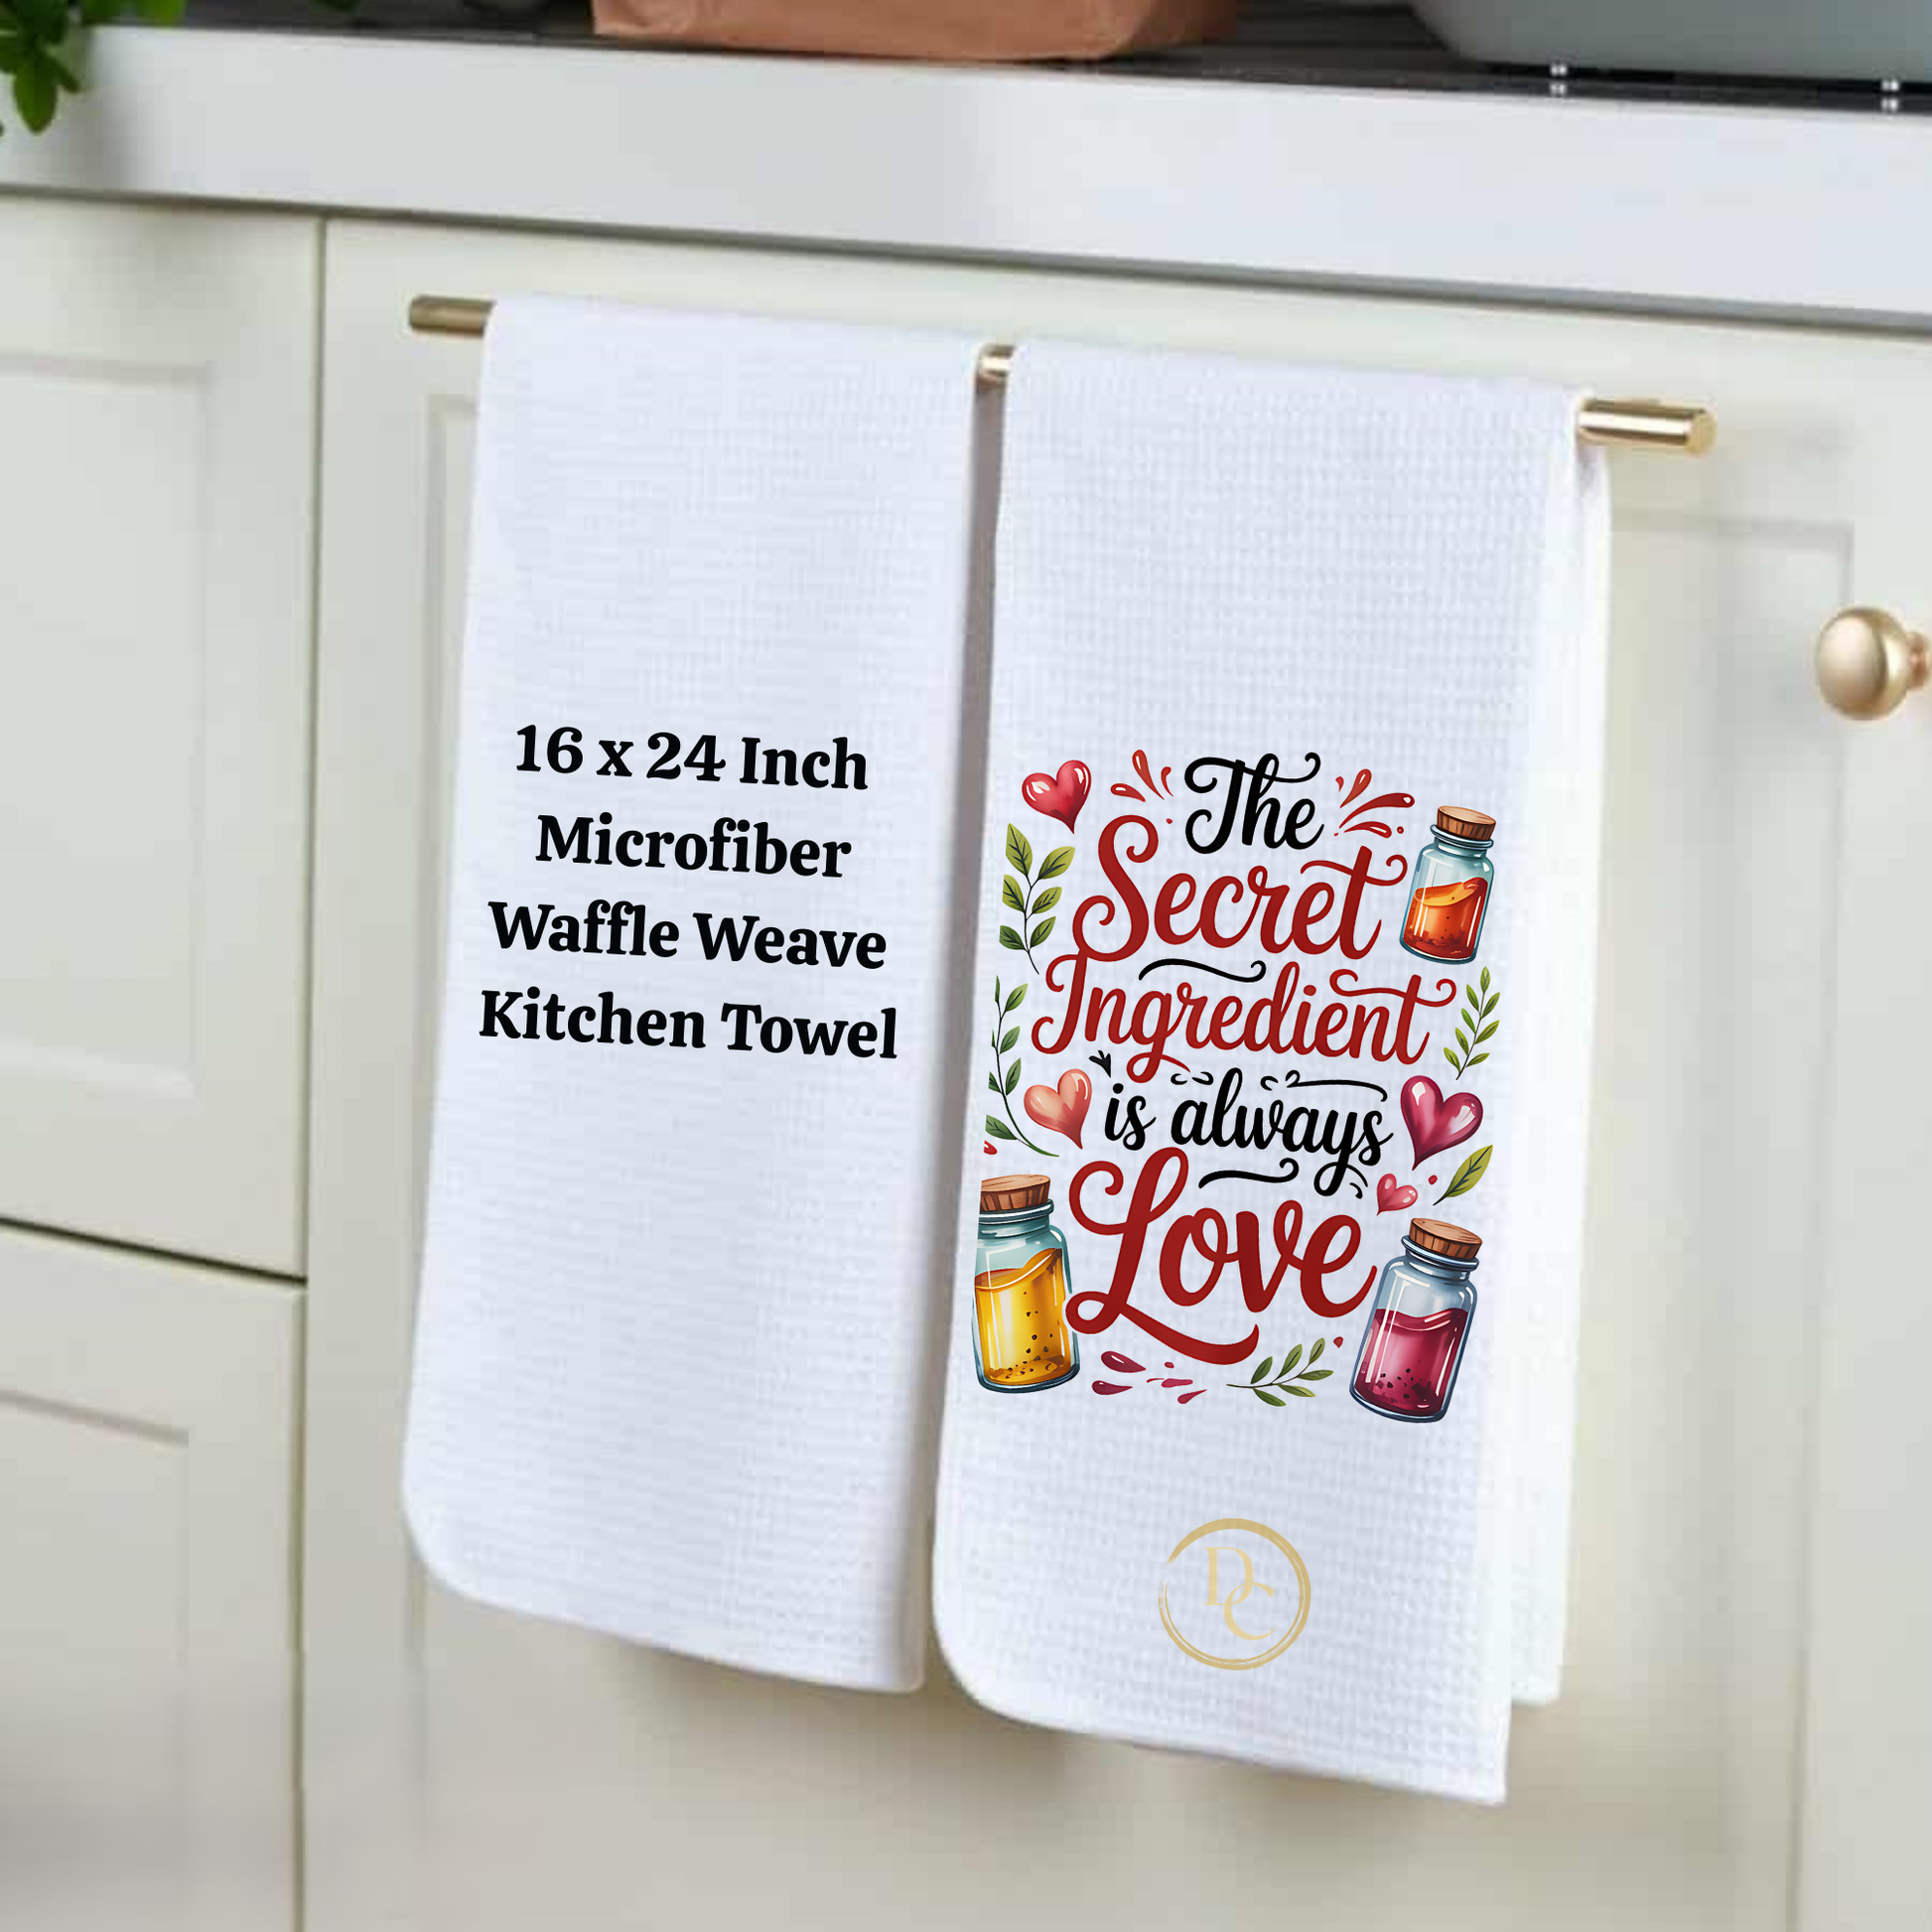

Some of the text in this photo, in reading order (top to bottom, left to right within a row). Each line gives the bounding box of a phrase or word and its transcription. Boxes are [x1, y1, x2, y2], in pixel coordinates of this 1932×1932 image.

[1183, 752, 1325, 855] The
[1072, 814, 1408, 962] Secret
[1031, 953, 1457, 1084] Ingredient
[1103, 1066, 1394, 1197] is always
[1065, 1147, 1378, 1366] Love
